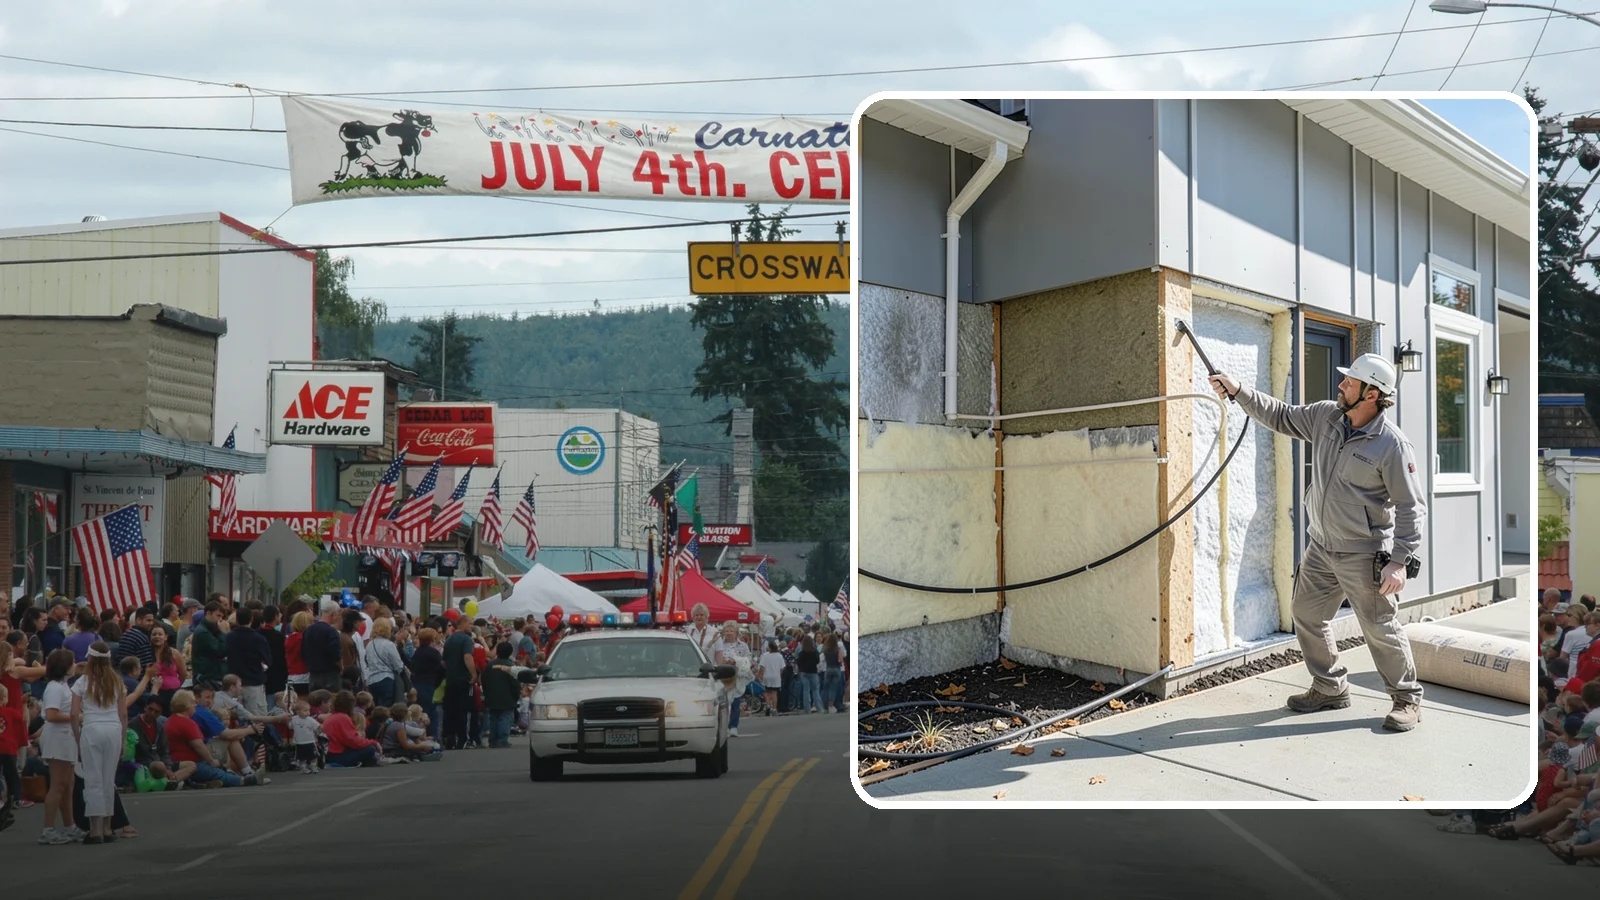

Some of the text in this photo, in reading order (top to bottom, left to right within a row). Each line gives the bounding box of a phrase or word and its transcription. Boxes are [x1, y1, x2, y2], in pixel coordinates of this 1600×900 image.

[481, 141, 605, 193] JULY
[632, 150, 746, 198] 4th.
[697, 254, 850, 280] CROSSWA
[283, 380, 373, 420] ACE
[405, 409, 453, 422] CEDAR
[283, 421, 370, 437] Hardware
[96, 485, 124, 495] Vincent
[126, 486, 136, 495] de
[138, 486, 155, 495] Paul
[688, 526, 741, 535] CRNATION
[699, 535, 730, 543] GLASS
